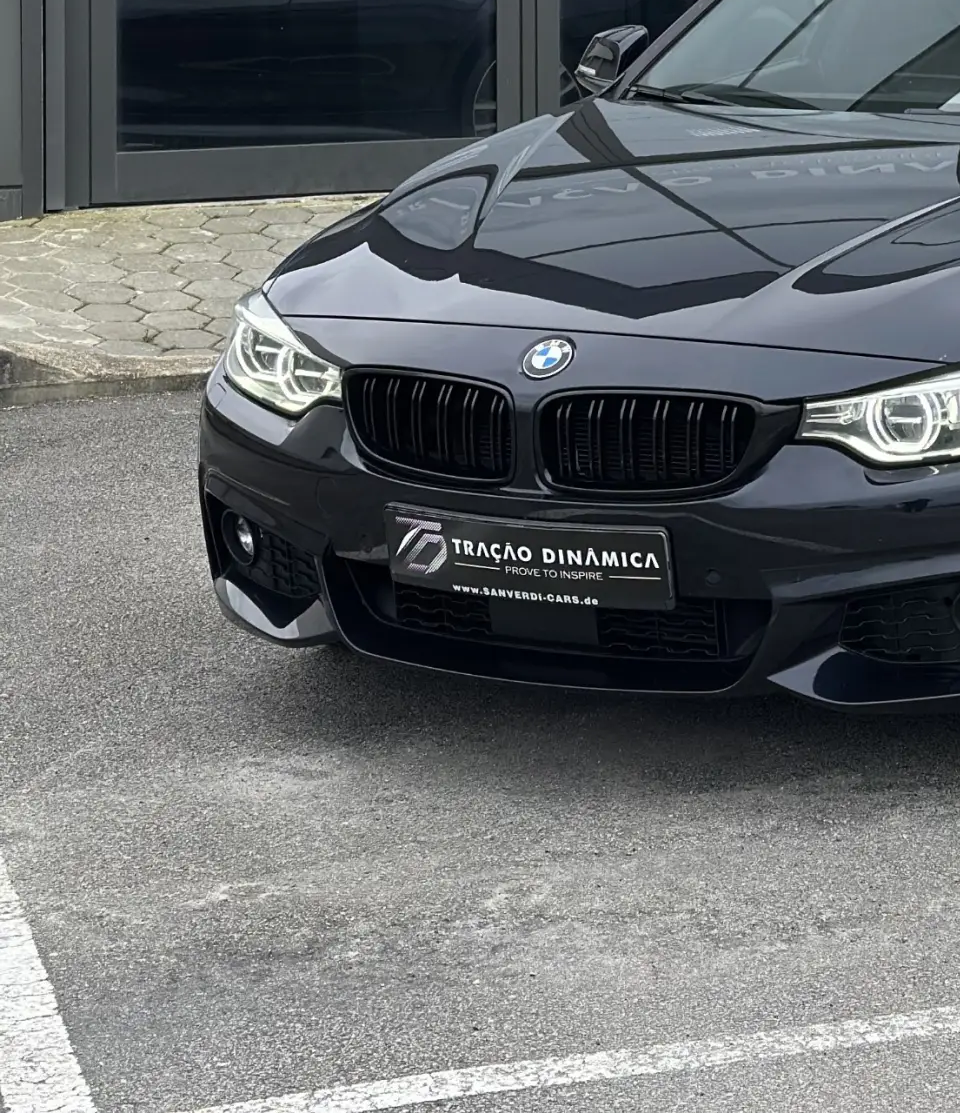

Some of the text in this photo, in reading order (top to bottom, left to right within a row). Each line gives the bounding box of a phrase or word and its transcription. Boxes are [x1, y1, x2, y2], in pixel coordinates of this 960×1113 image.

[451, 538, 660, 569] TRAÇÃO DINÂMICA
[505, 566, 604, 581] PROVE TO INSPIRE
